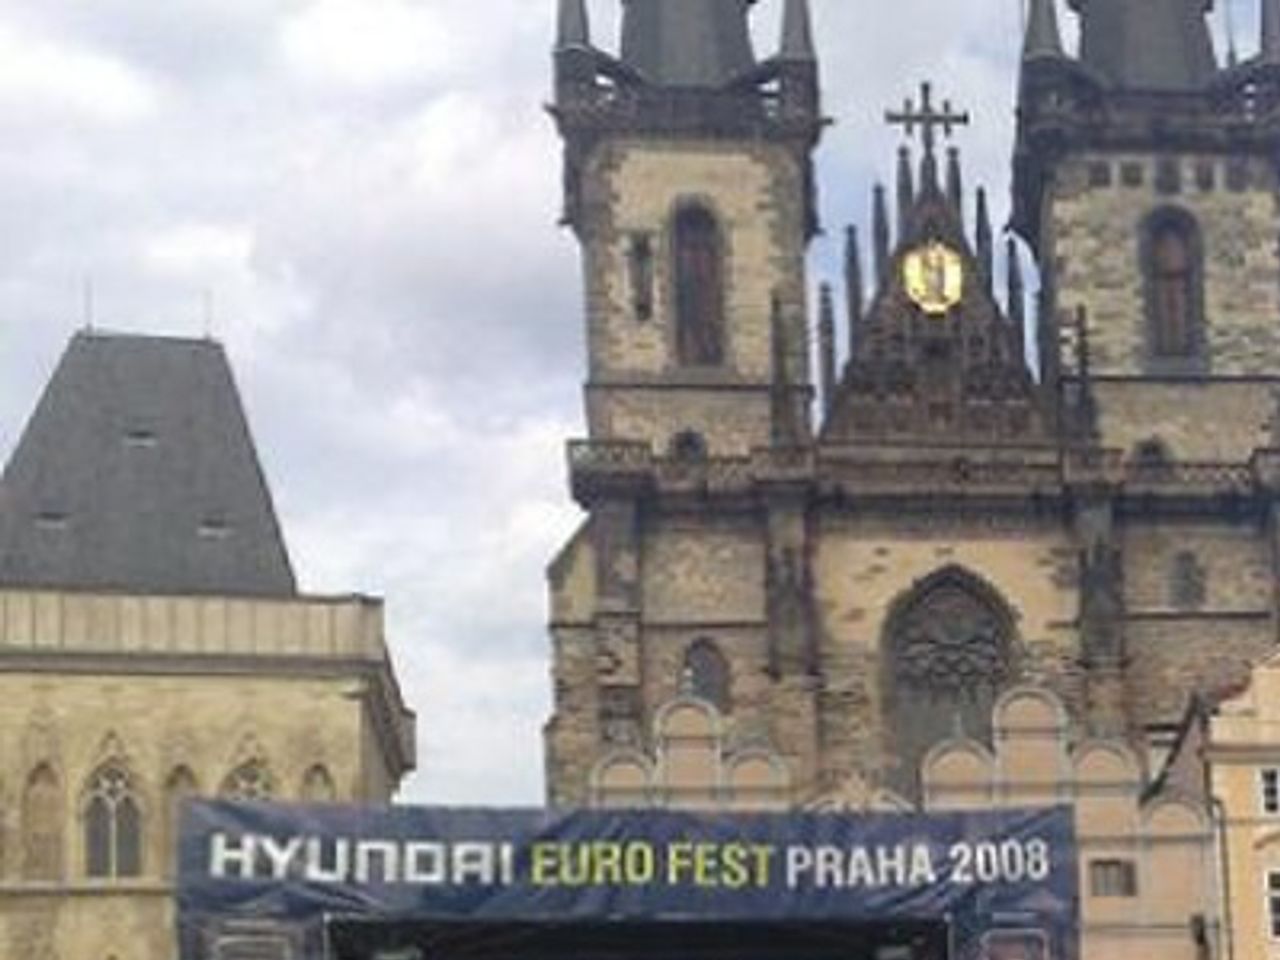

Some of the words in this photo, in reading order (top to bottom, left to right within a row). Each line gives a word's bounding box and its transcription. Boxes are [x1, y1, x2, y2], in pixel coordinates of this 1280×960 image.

[209, 831, 515, 886] HYUNDAI
[530, 840, 656, 887] EURO
[666, 841, 775, 888] FEST
[785, 843, 937, 889] PRAHA
[948, 837, 1051, 884] 2008
